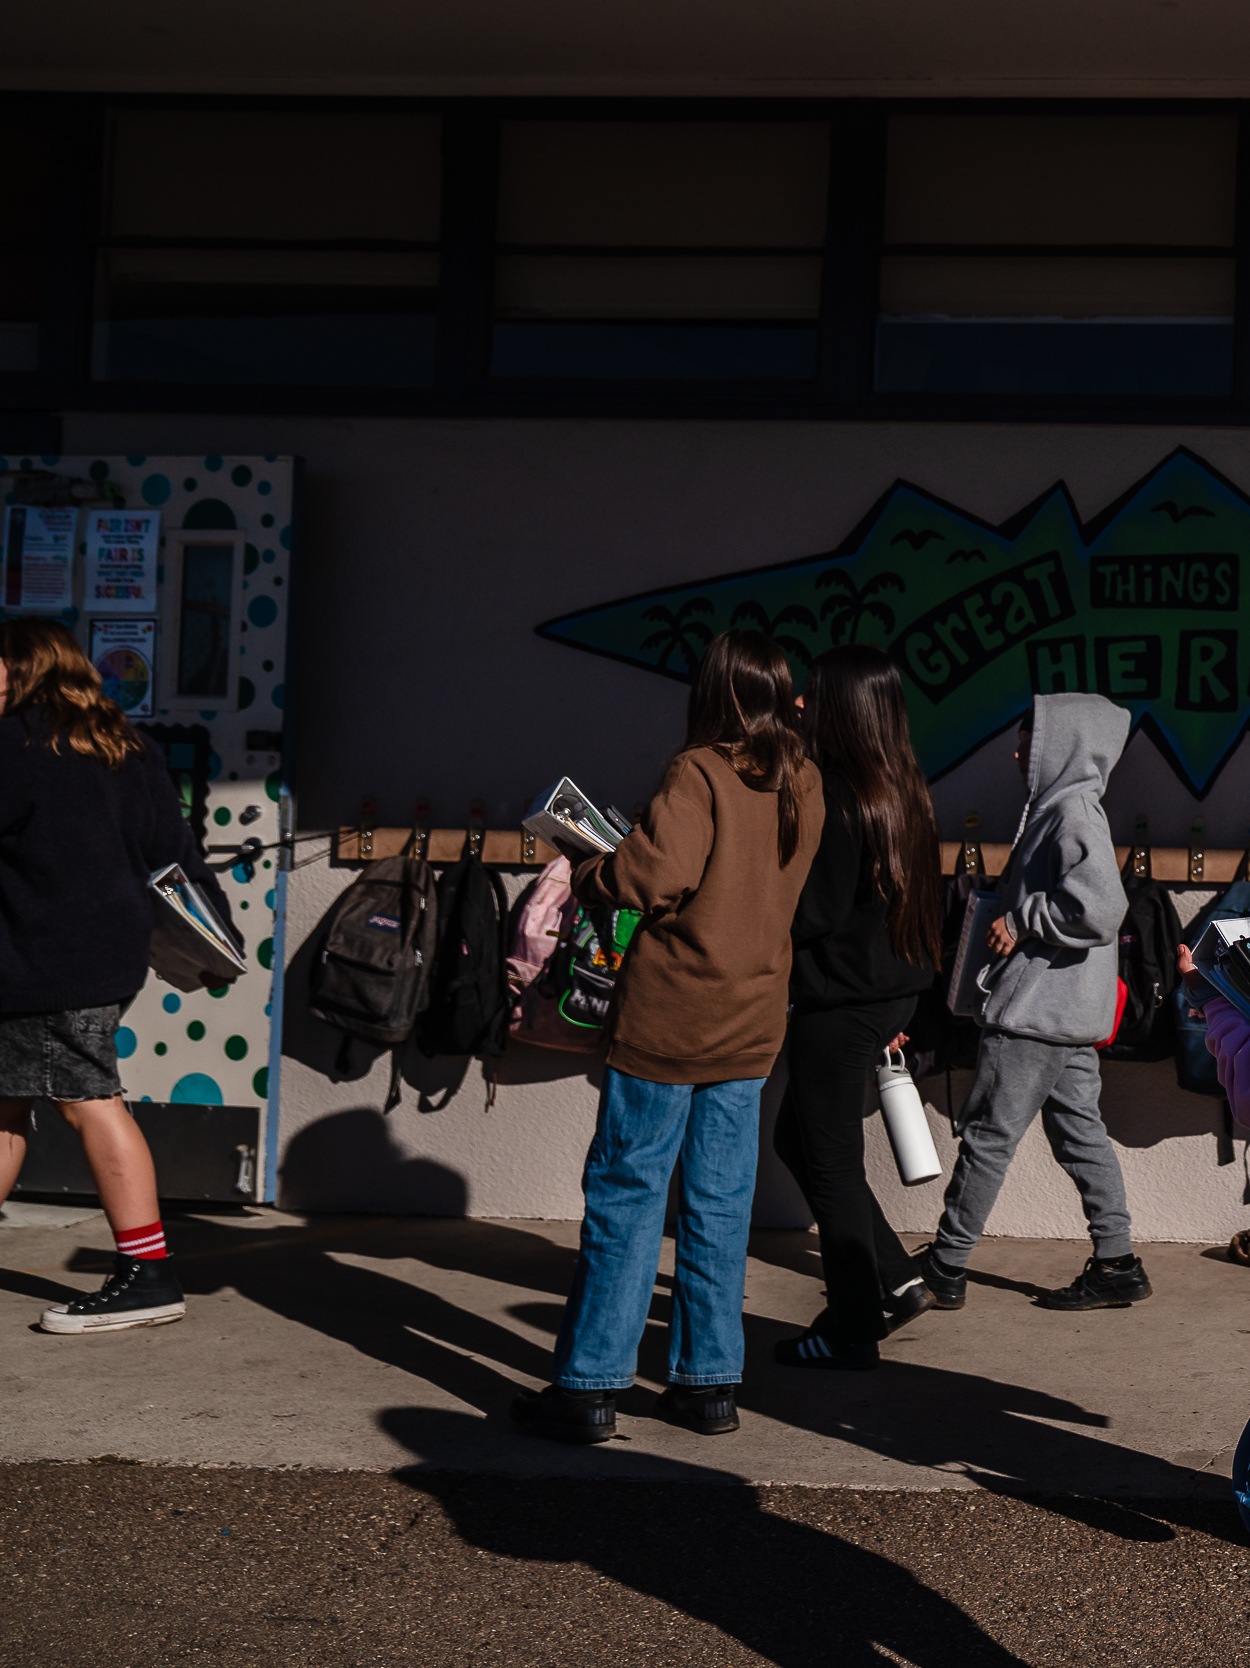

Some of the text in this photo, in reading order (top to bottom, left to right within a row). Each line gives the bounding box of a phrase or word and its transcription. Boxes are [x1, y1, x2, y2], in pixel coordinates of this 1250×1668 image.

[98, 547, 145, 562] FAIR IS
[704, 1400, 735, 1419] NIK
